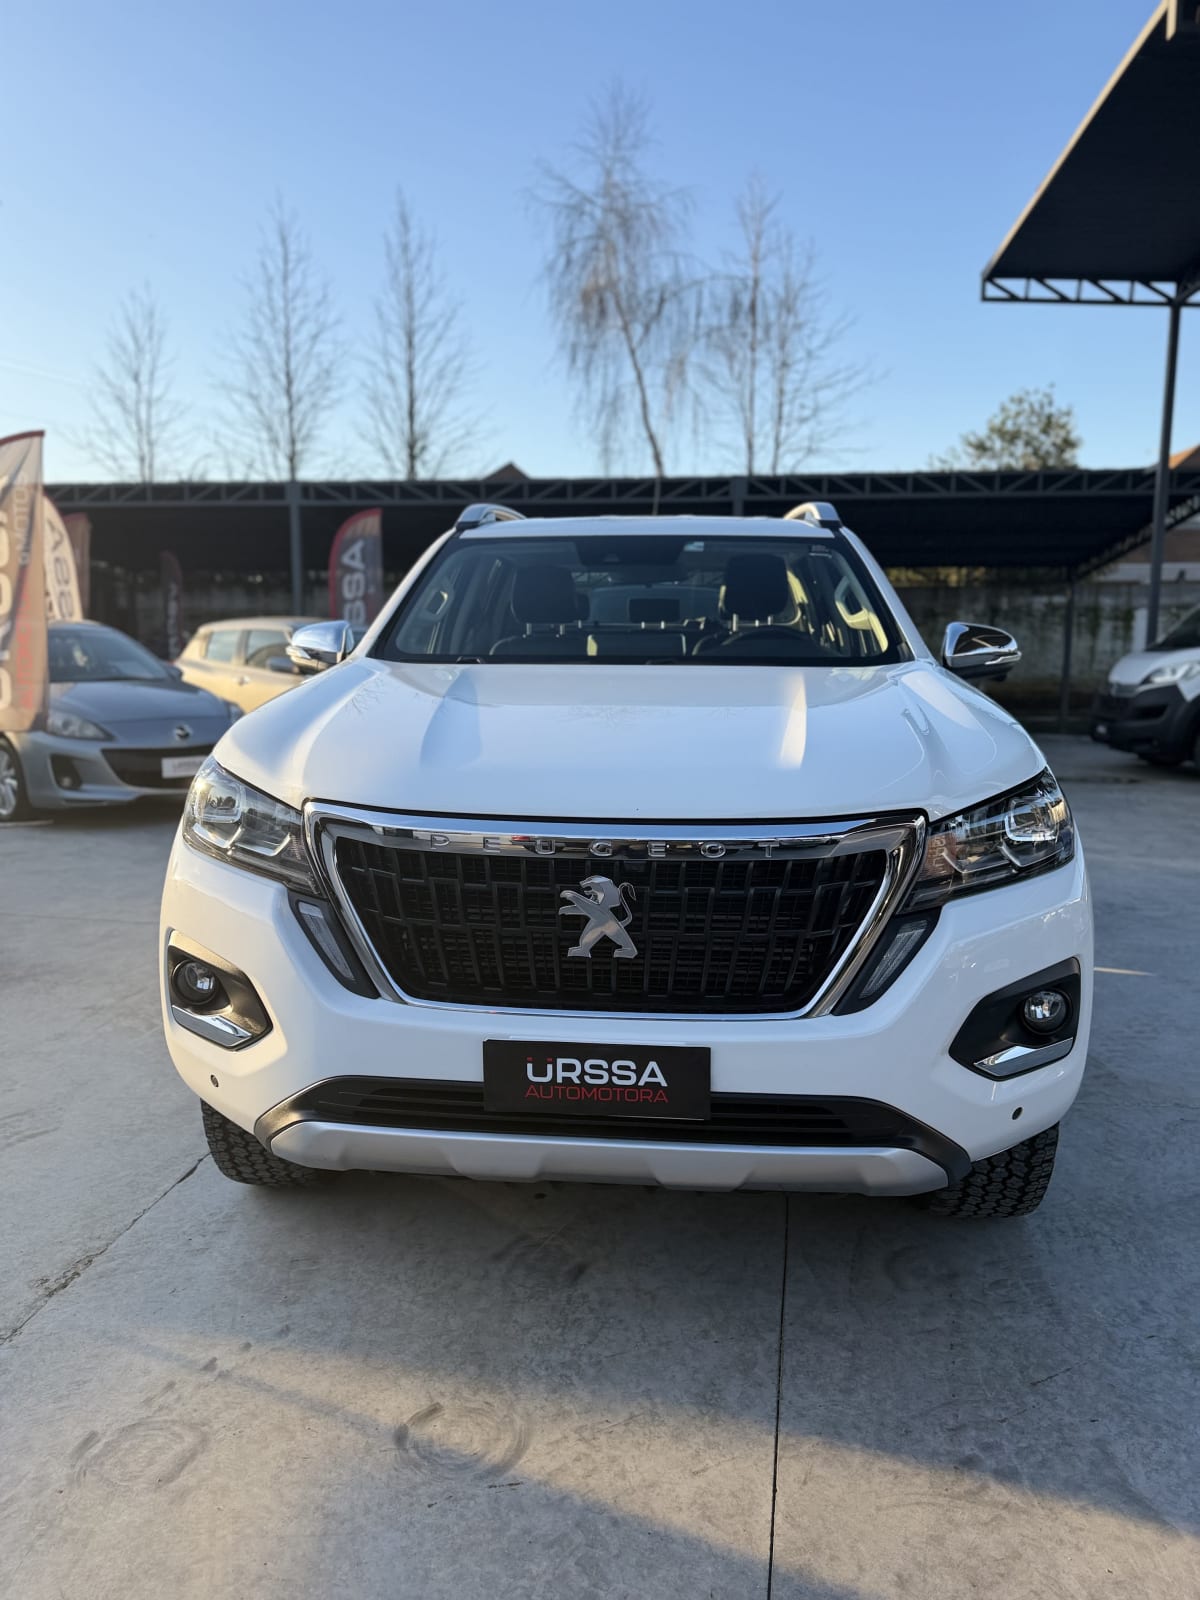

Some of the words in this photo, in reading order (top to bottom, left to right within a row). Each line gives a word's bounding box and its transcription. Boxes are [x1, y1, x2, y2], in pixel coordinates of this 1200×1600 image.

[341, 538, 366, 630] SSA
[430, 834, 780, 858] PEUGEOT
[525, 1084, 669, 1104] AUTOMOTORA
